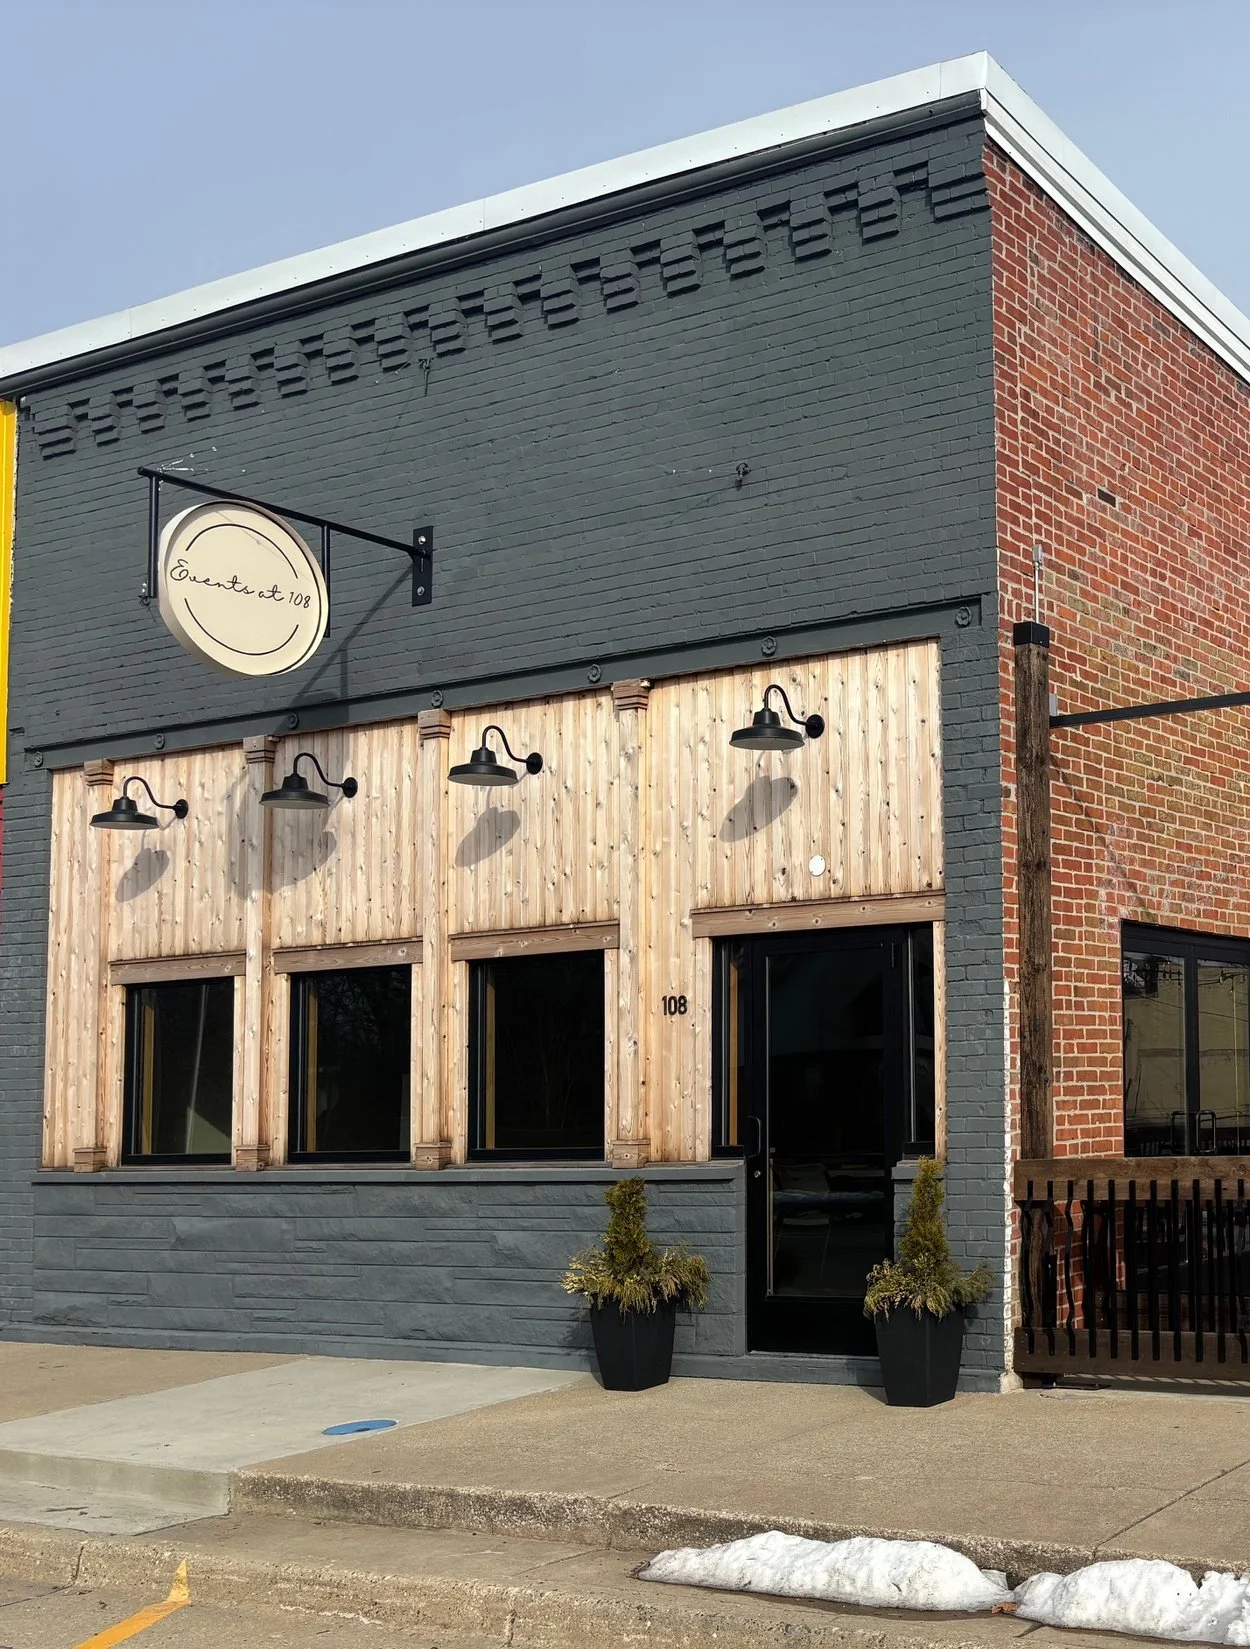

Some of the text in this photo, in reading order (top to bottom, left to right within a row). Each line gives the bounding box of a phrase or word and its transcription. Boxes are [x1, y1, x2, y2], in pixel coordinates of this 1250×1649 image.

[170, 558, 311, 609] Events at 108
[661, 994, 688, 1016] 108
